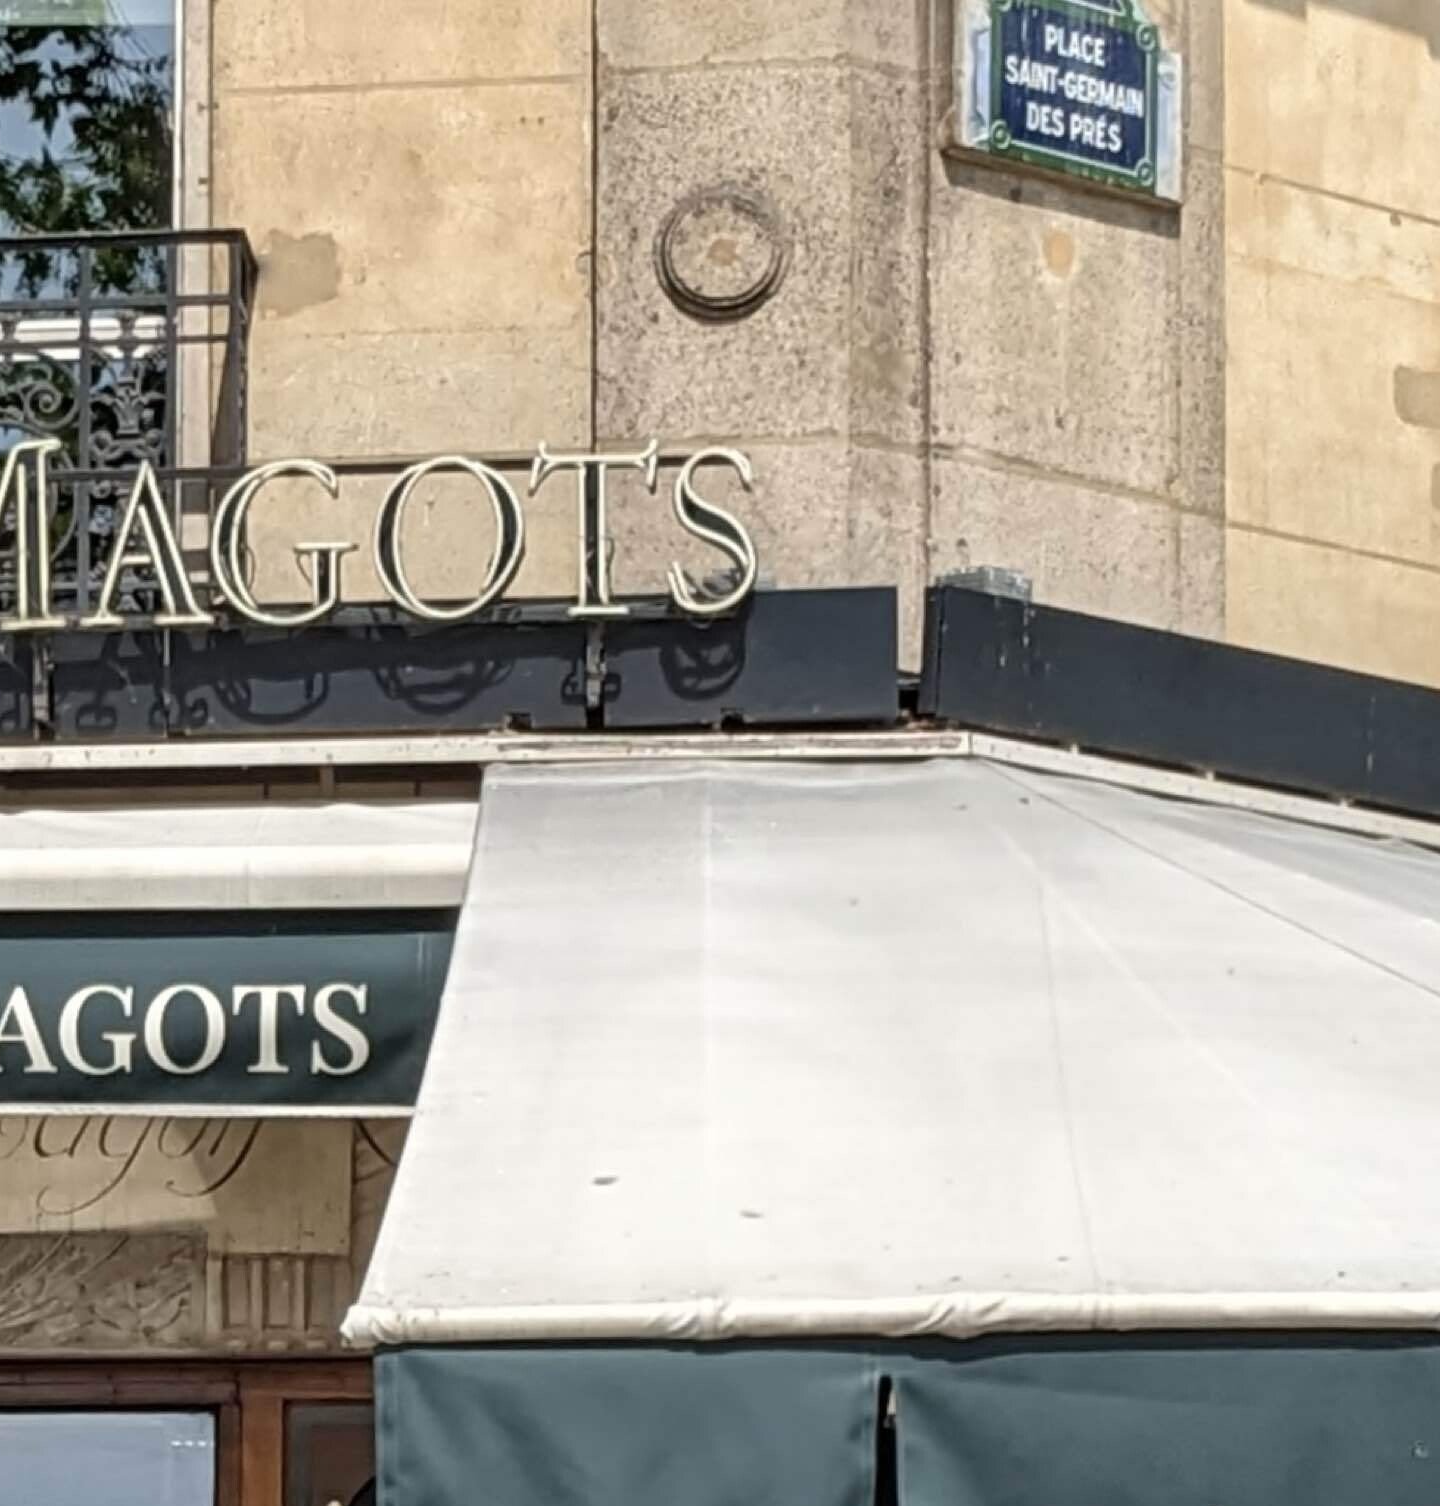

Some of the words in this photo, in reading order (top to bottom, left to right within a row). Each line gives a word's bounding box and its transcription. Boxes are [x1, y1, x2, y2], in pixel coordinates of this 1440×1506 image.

[1044, 24, 1105, 67] PLACE
[1005, 55, 1145, 118] SAINT-GERMAIN
[1026, 102, 1065, 137] DES
[1070, 114, 1123, 153] PRÉS
